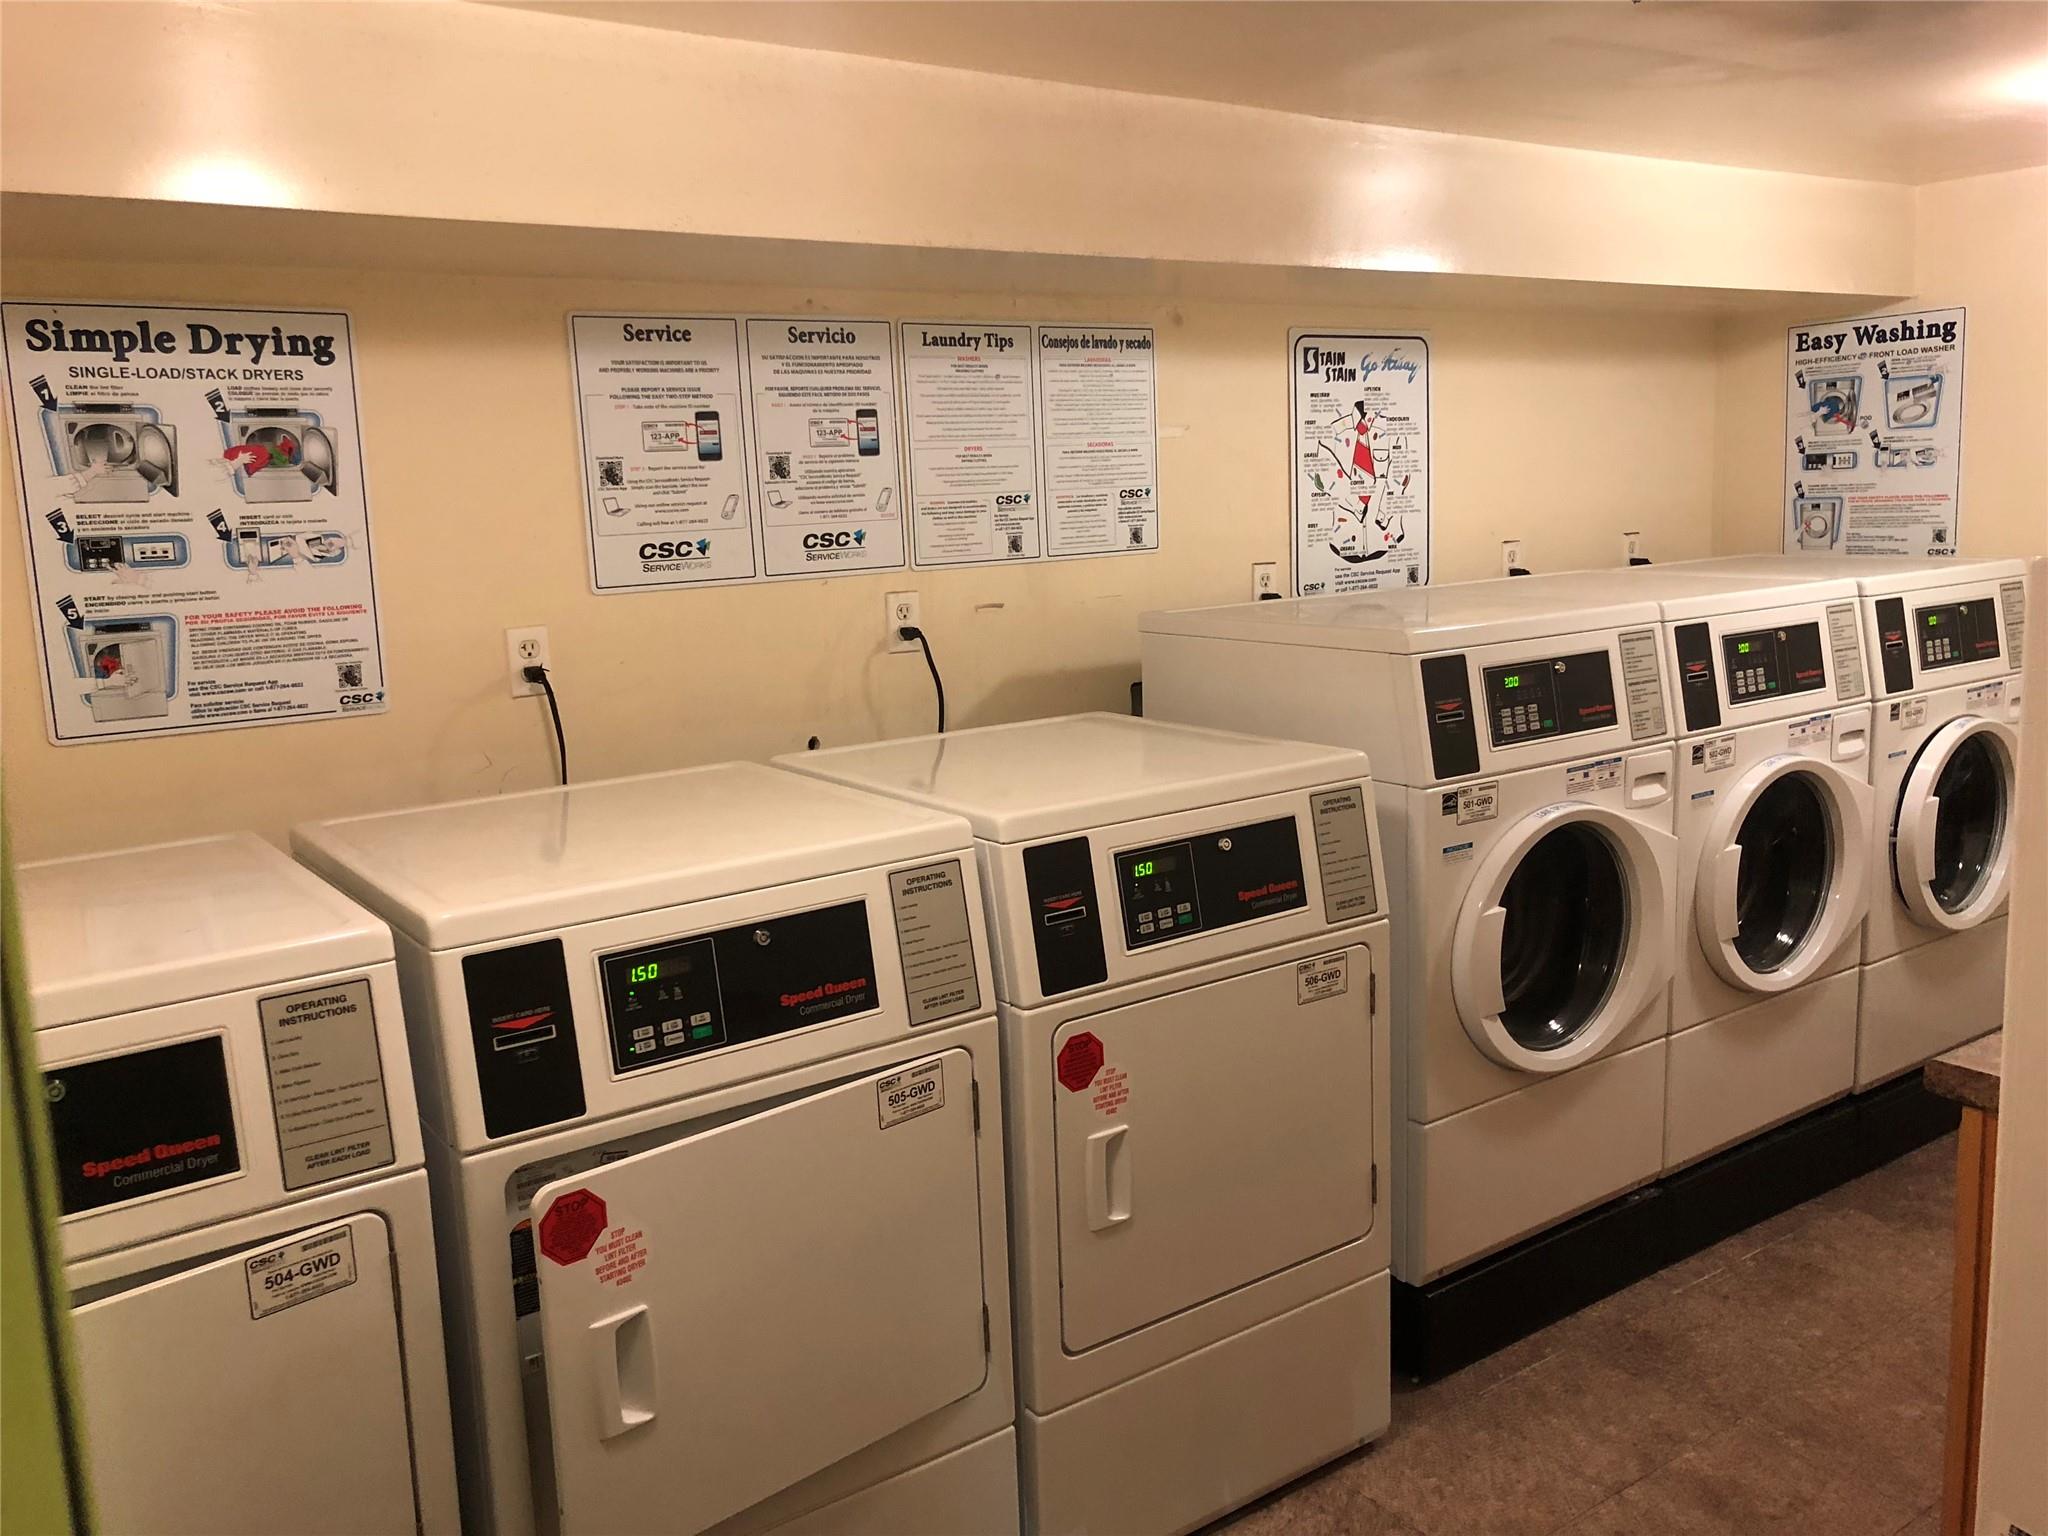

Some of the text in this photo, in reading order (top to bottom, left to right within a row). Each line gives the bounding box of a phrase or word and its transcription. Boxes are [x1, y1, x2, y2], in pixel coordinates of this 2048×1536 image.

[25, 319, 337, 365] Simple Drying
[623, 323, 693, 343] Service
[788, 326, 856, 344] Servicio
[921, 331, 1015, 352] Laundry Tips
[1795, 319, 1957, 354] Easy Washing
[1041, 334, 1151, 353] Consejos de lavado y secado
[1795, 344, 1956, 366] HIGH-EFFICIENCY FRONT LOAD WASHER
[68, 367, 304, 381] SINGLE-LOAD/STACK DRYERS
[1303, 347, 1346, 374] STAIN
[1325, 367, 1357, 383] STAIN
[214, 402, 226, 413] 2
[650, 432, 680, 441] 123-APP
[816, 429, 843, 437] 123-APP
[995, 495, 1023, 505] CSC
[1119, 488, 1143, 499] CSC
[56, 521, 68, 533] 3
[217, 521, 228, 532] 4
[802, 531, 850, 549] CSC
[639, 541, 693, 561] CSC
[1927, 548, 1948, 556] CSC
[1303, 583, 1320, 591] CSC
[68, 607, 78, 620] 5
[322, 603, 363, 612] FOLLOWING
[340, 693, 374, 705] CSC
[1322, 796, 1352, 807] OPERATING
[906, 871, 947, 886] OPERATING
[902, 879, 953, 897] INSTRUCTIONS
[1237, 880, 1298, 903] Speed Queen
[1305, 969, 1341, 987] 506-GWD
[780, 978, 867, 1007] Speed Queen
[286, 994, 348, 1015] OPERATING
[279, 1004, 358, 1028] INSTRUCTIONS
[880, 1078, 897, 1089] CSC
[888, 1081, 936, 1107] 505-GWD
[82, 1134, 221, 1178] Speed Queen
[305, 1141, 371, 1163] CLEAN LINT FILTER
[307, 1149, 371, 1170] AFTER EACH LOAD
[113, 1152, 219, 1188] Commercial Dryer
[555, 1196, 592, 1214] STOP
[608, 1237, 624, 1250] MUST
[624, 1230, 643, 1243] CLEAN
[611, 1227, 625, 1240] STOP
[595, 1260, 617, 1275] BEFORE
[630, 1248, 647, 1260] AFTER
[604, 1243, 636, 1262] LINT FILTER
[250, 1254, 276, 1270] CSC
[264, 1252, 342, 1290] 504-GWD
[600, 1258, 646, 1284] STARTING DRYER
